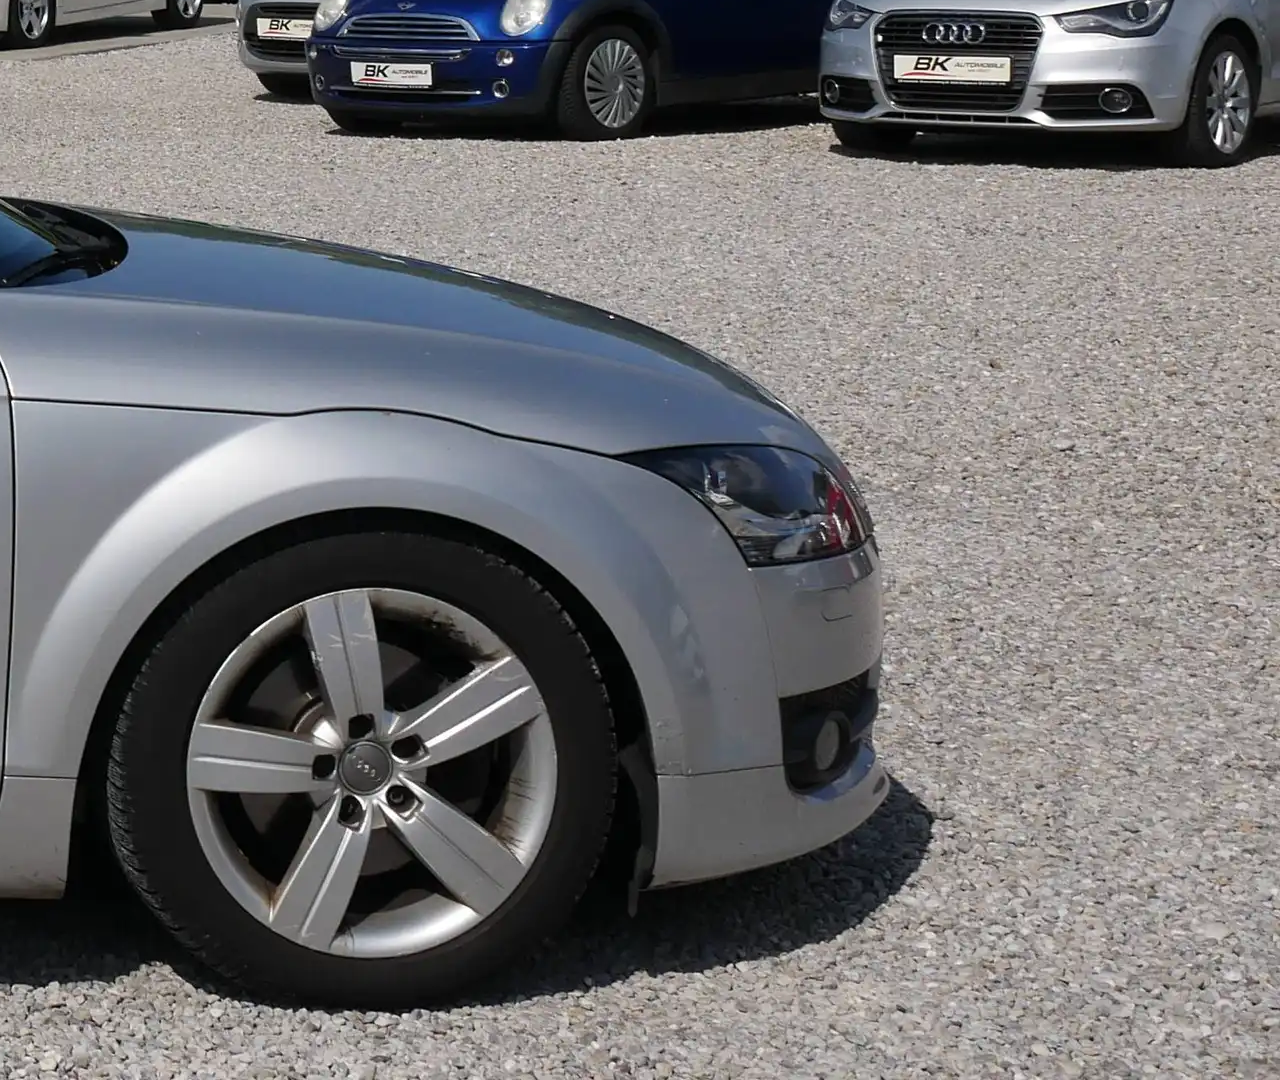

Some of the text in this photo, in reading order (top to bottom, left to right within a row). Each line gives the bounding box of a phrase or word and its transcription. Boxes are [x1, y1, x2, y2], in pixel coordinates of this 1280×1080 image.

[269, 19, 292, 31] BK
[364, 64, 390, 78] BK
[913, 56, 953, 72] BK
